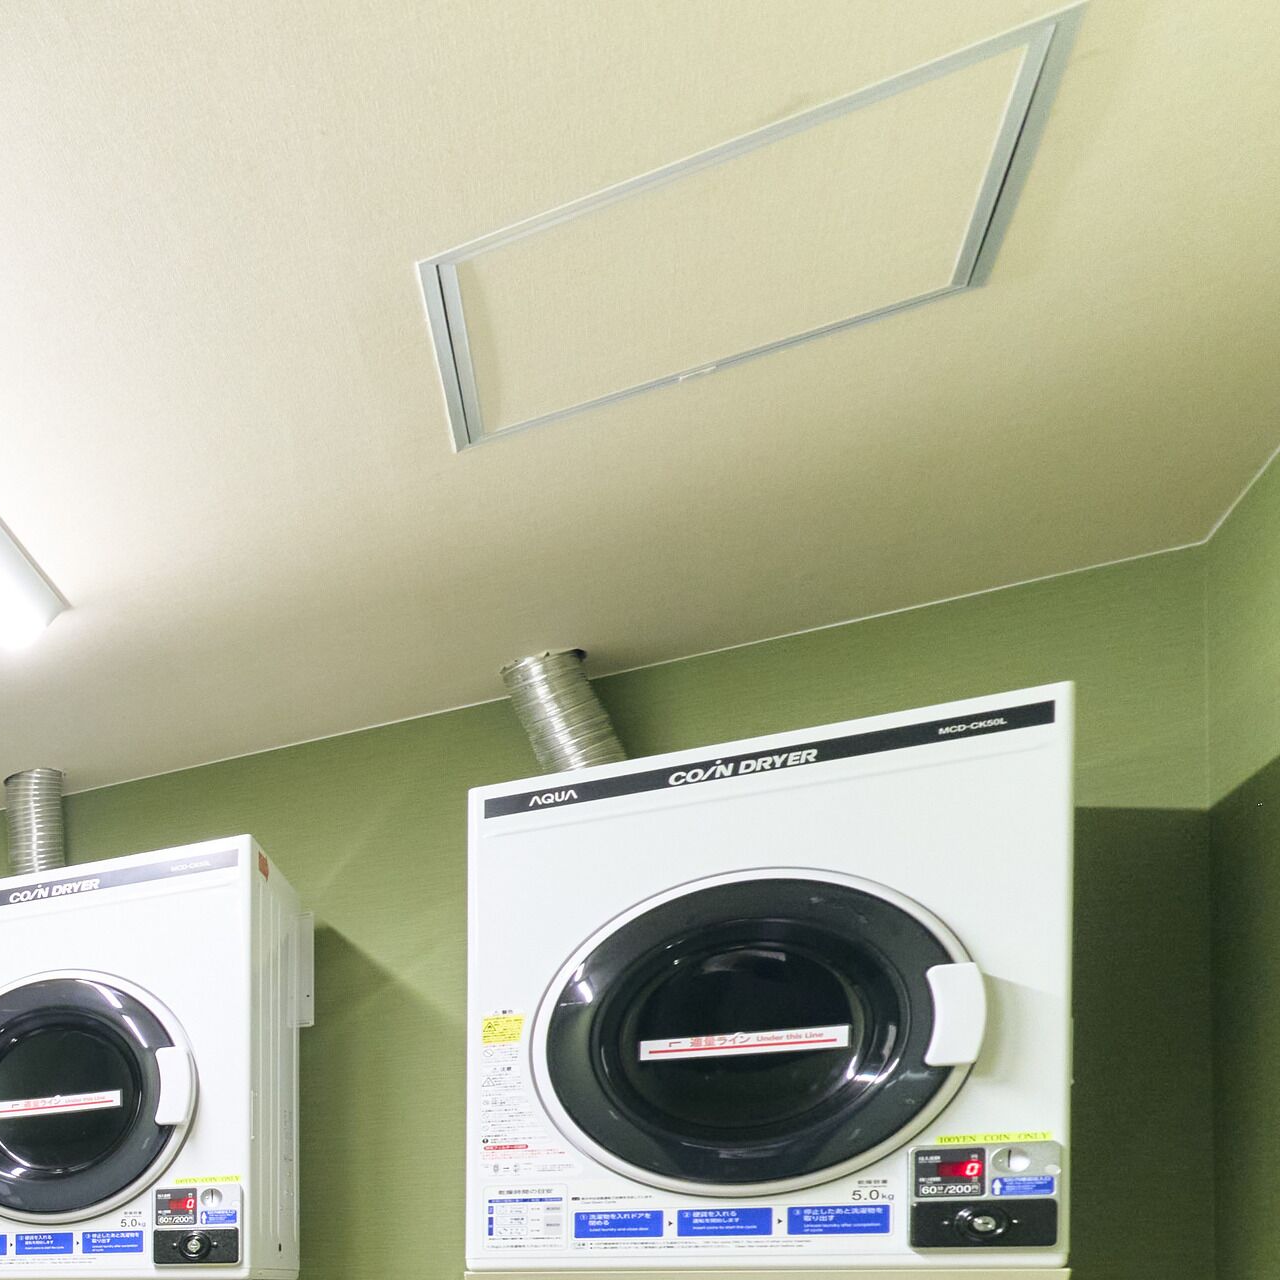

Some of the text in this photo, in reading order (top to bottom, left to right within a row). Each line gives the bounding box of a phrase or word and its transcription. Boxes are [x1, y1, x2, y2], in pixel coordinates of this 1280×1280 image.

[668, 748, 818, 786] COIN DRYER
[529, 788, 578, 807] AQUA
[9, 879, 100, 903] COIN DRYER
[805, 1031, 823, 1039] Line
[965, 1163, 980, 1176] 0
